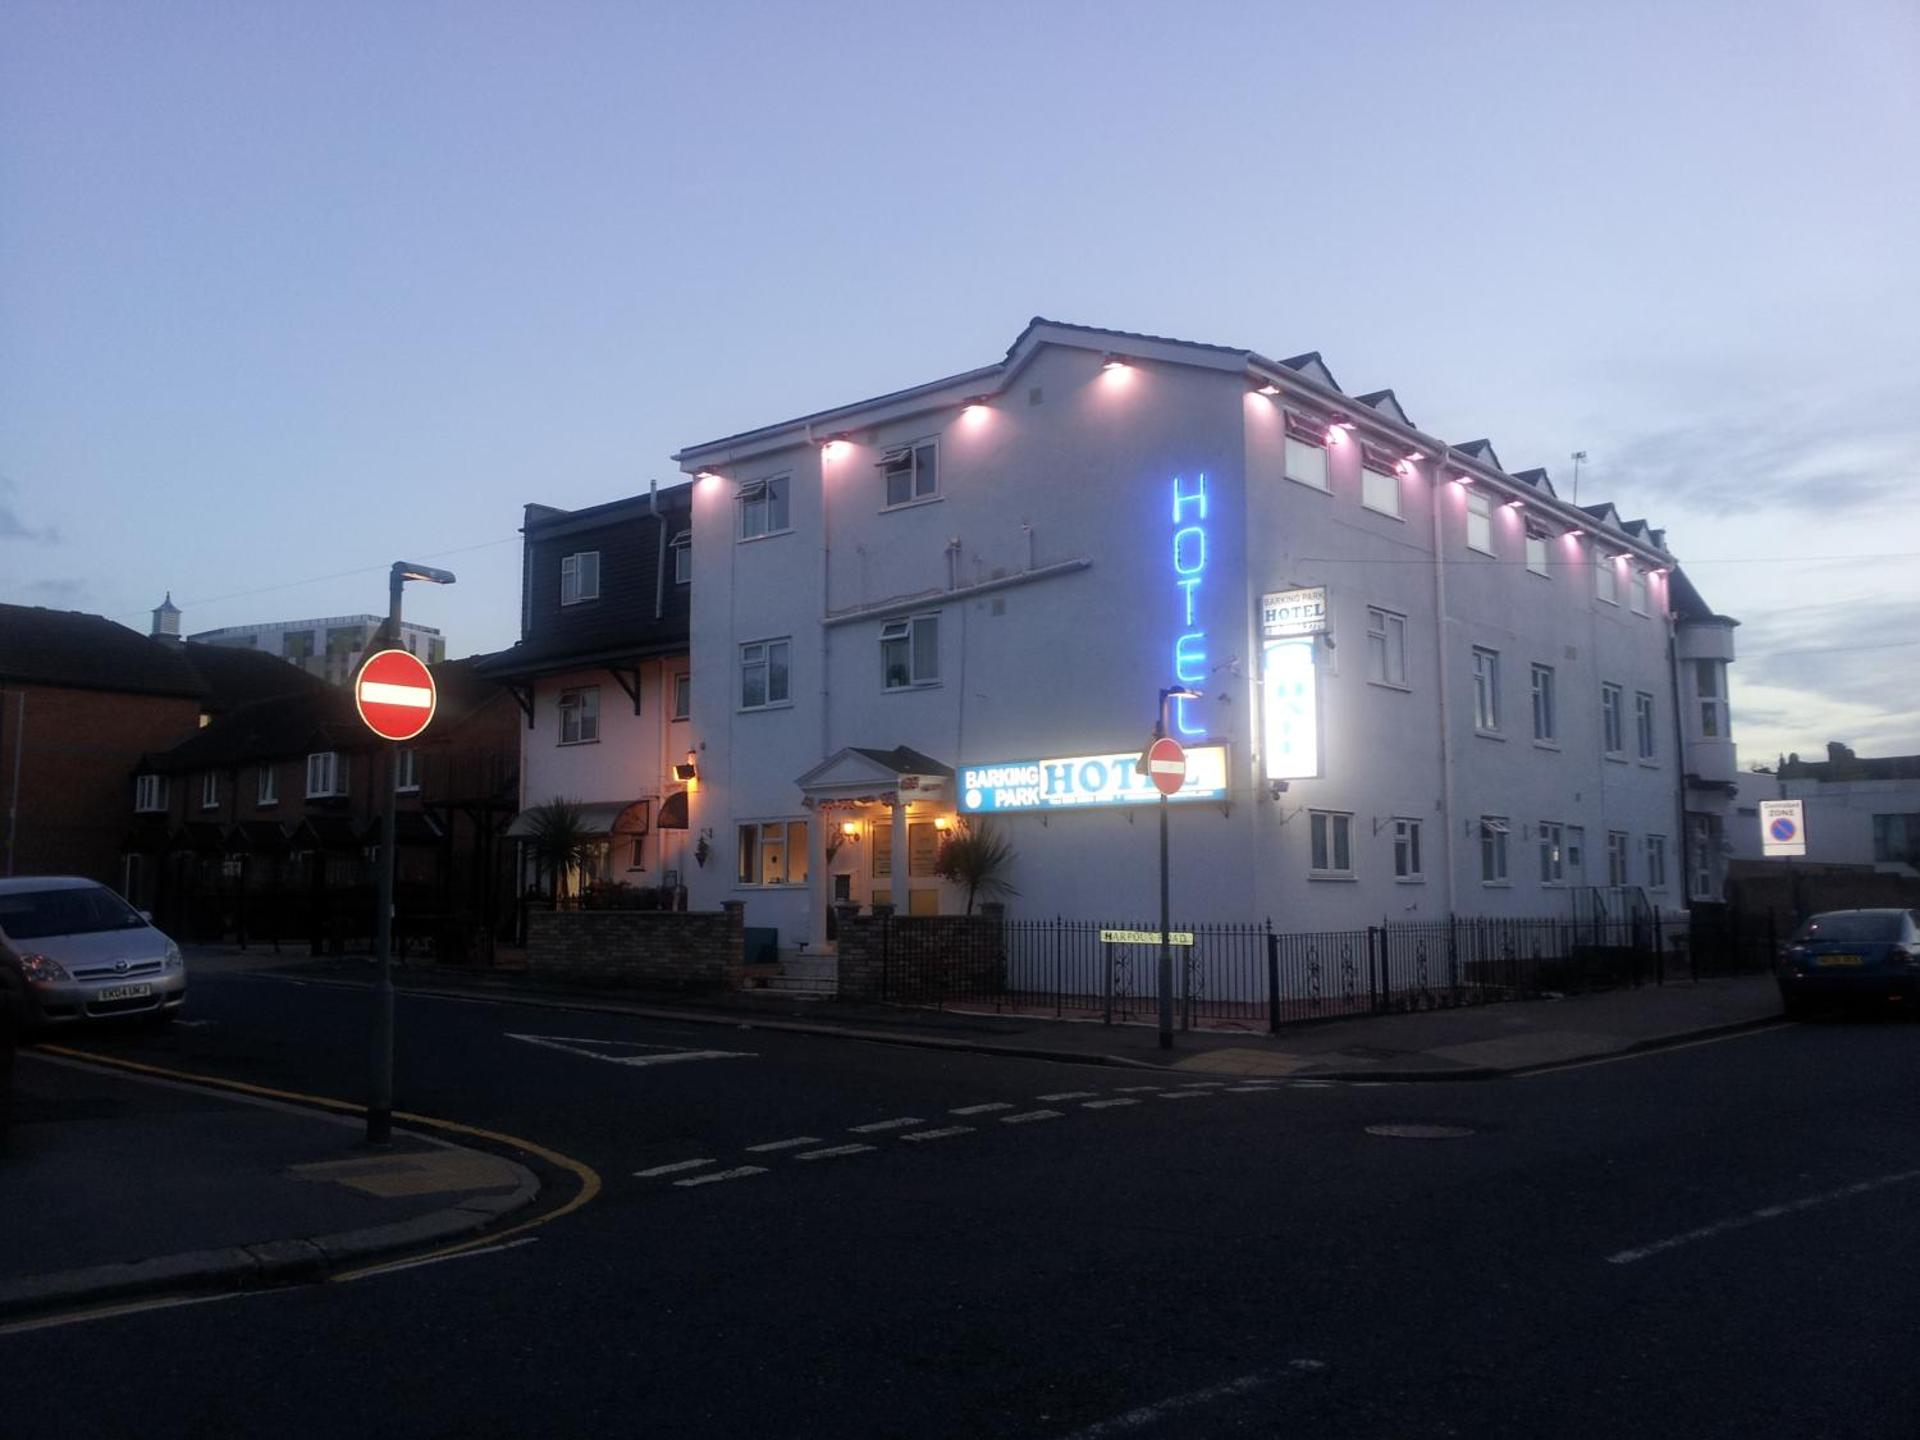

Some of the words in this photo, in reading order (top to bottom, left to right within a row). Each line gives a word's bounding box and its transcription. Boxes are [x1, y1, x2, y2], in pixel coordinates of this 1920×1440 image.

[1173, 472, 1207, 735] HOTEL
[1265, 604, 1325, 622] HOTEL
[965, 764, 1038, 788] BARKING
[1045, 757, 1200, 795] HOT
[995, 788, 1040, 807] PARK
